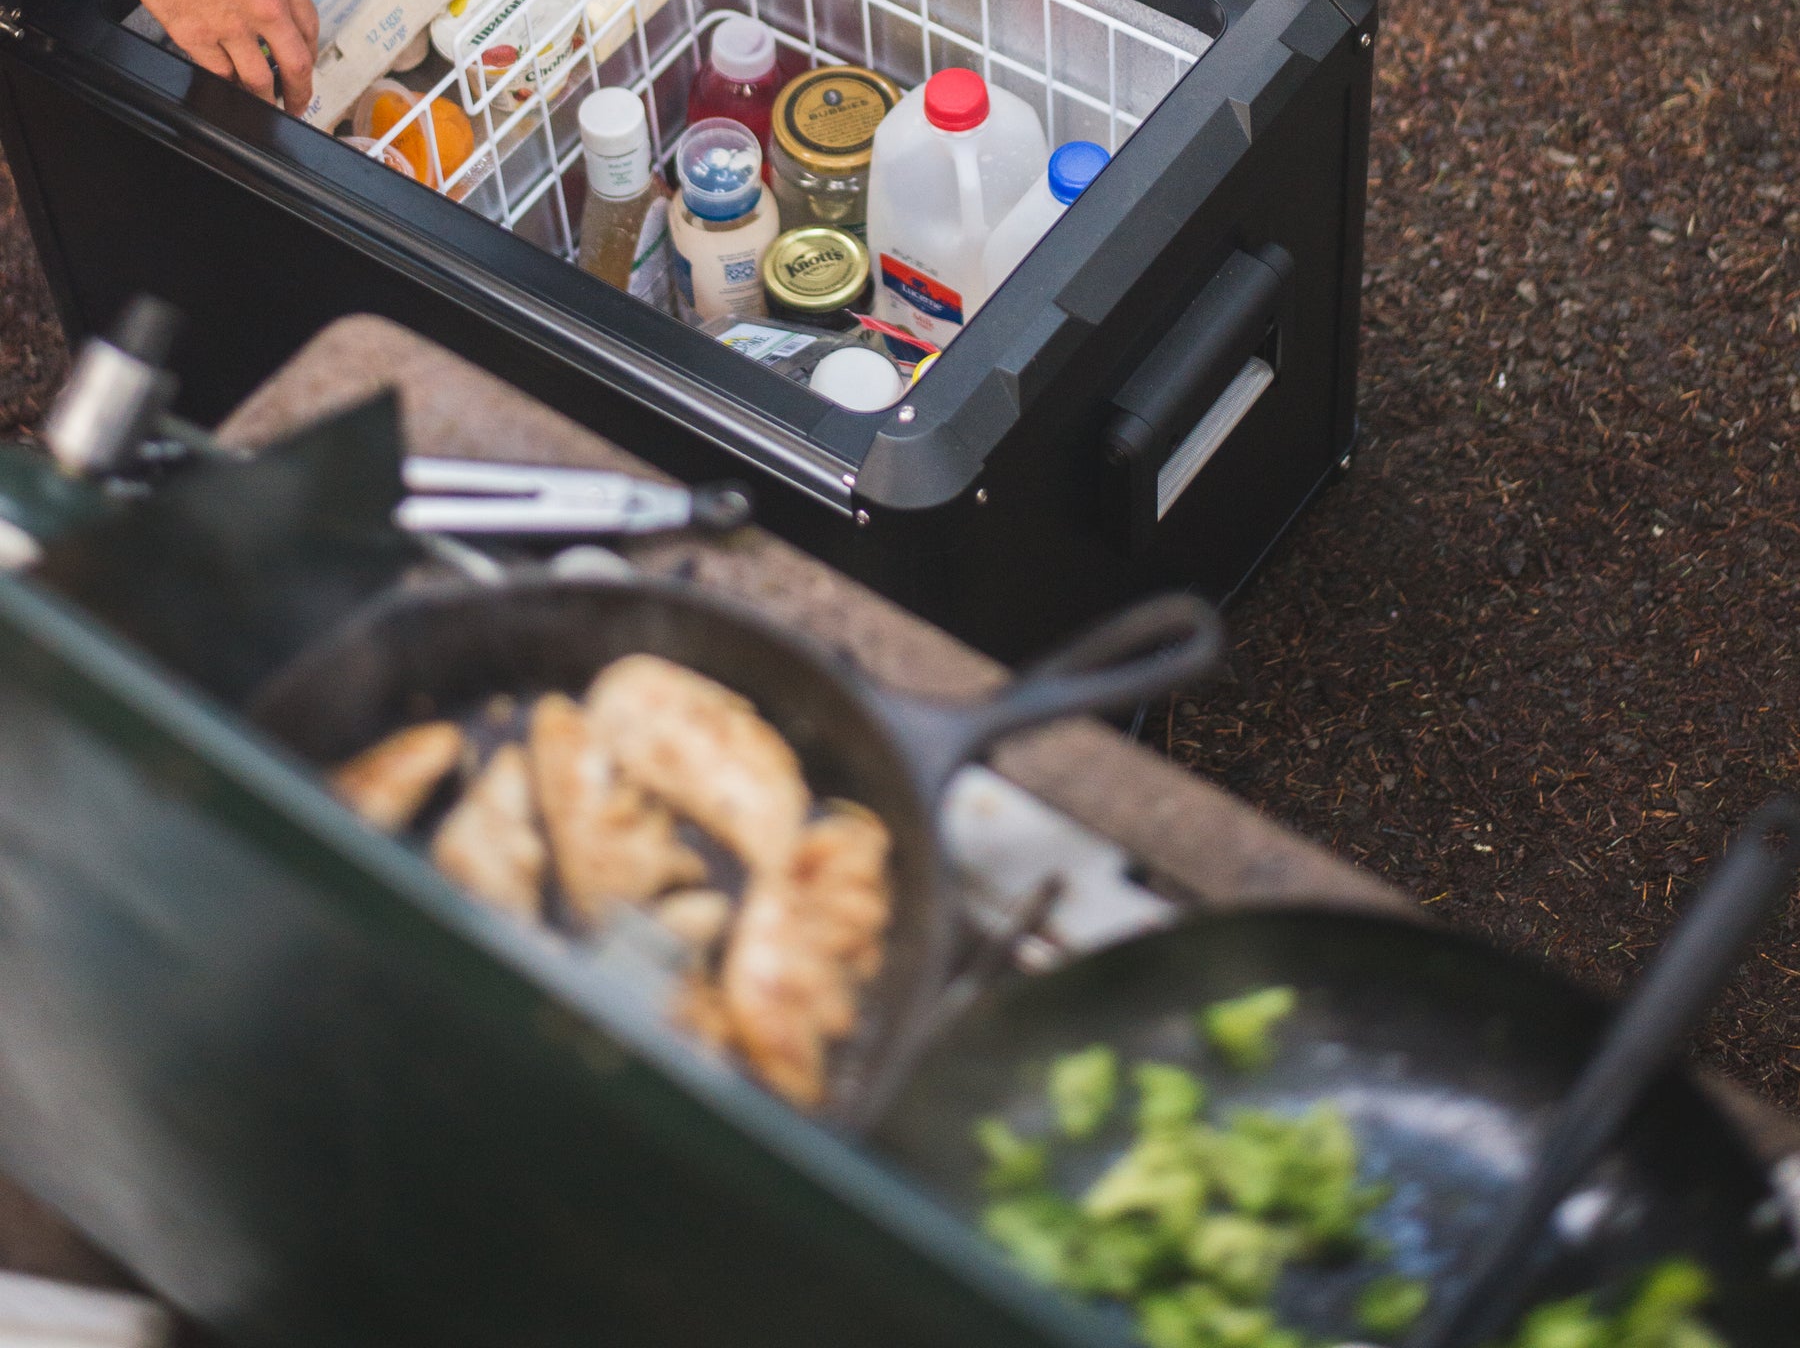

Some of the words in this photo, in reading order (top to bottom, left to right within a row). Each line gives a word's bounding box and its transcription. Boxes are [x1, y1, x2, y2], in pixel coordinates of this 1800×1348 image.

[366, 29, 381, 44] 12
[380, 7, 404, 34] Eggs
[382, 26, 408, 52] Large
[809, 100, 869, 121] BUBBIES
[784, 247, 844, 278] Knott's
[902, 283, 944, 312] Lucerne
